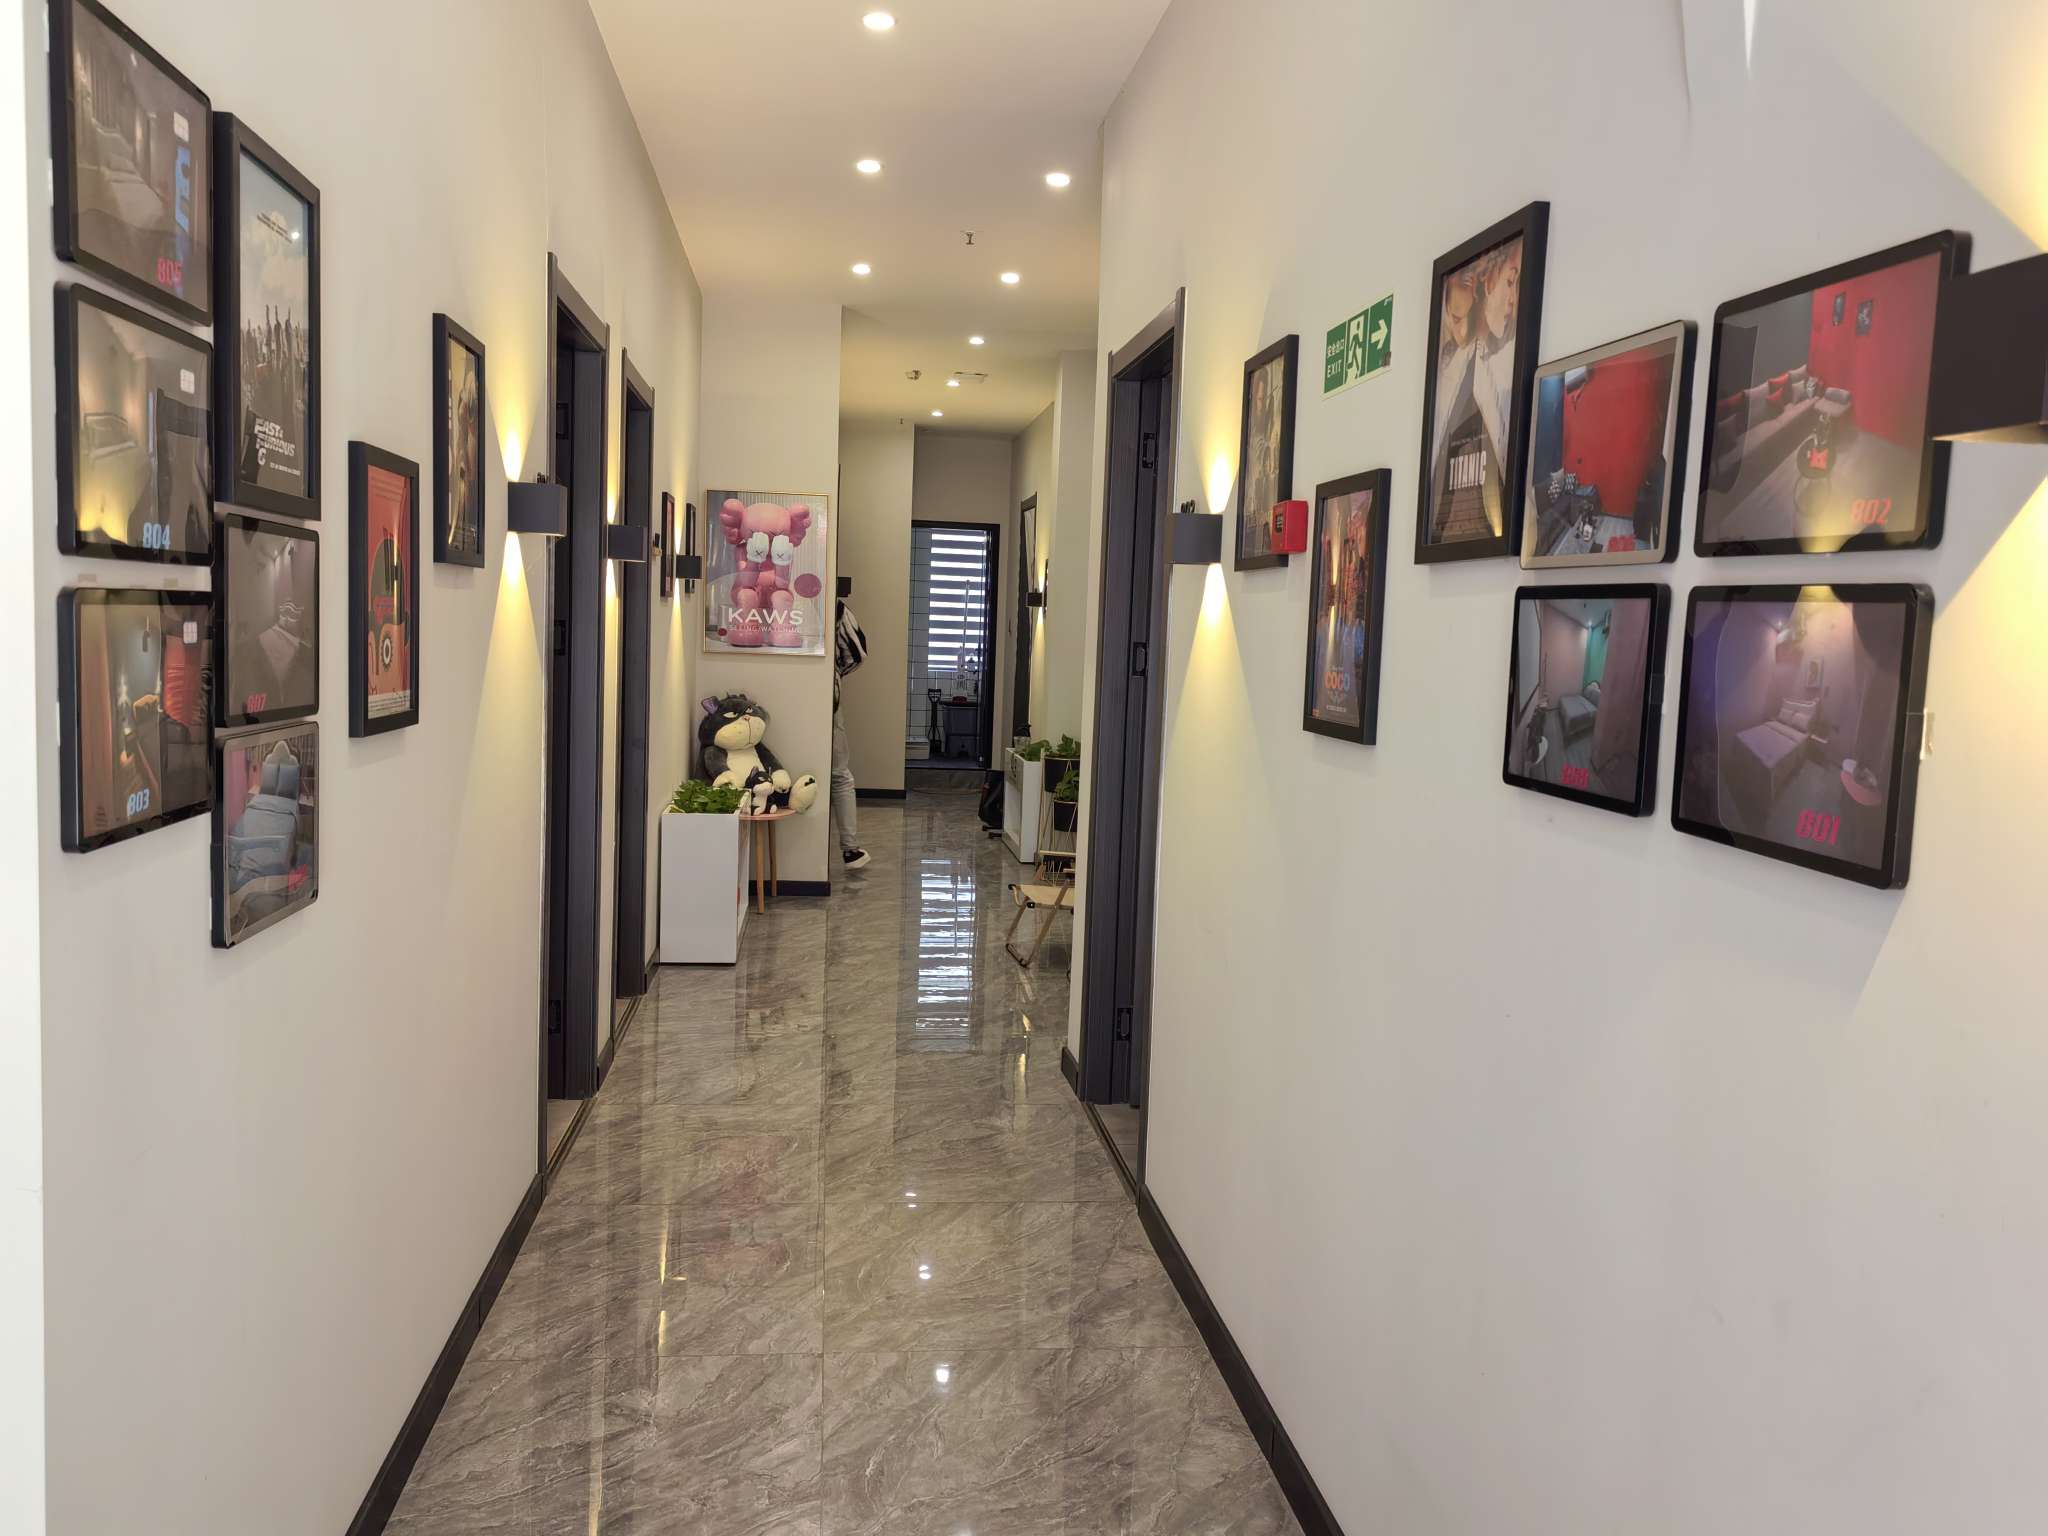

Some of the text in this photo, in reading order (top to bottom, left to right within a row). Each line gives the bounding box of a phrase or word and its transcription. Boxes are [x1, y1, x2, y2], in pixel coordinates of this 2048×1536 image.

[1327, 360, 1342, 378] EXIT
[1449, 450, 1487, 490] TITANIC
[1850, 497, 1892, 527] 802
[143, 521, 170, 550] 804
[728, 607, 803, 625] KAWS
[127, 788, 150, 816] 803
[1795, 809, 1840, 846] 801
